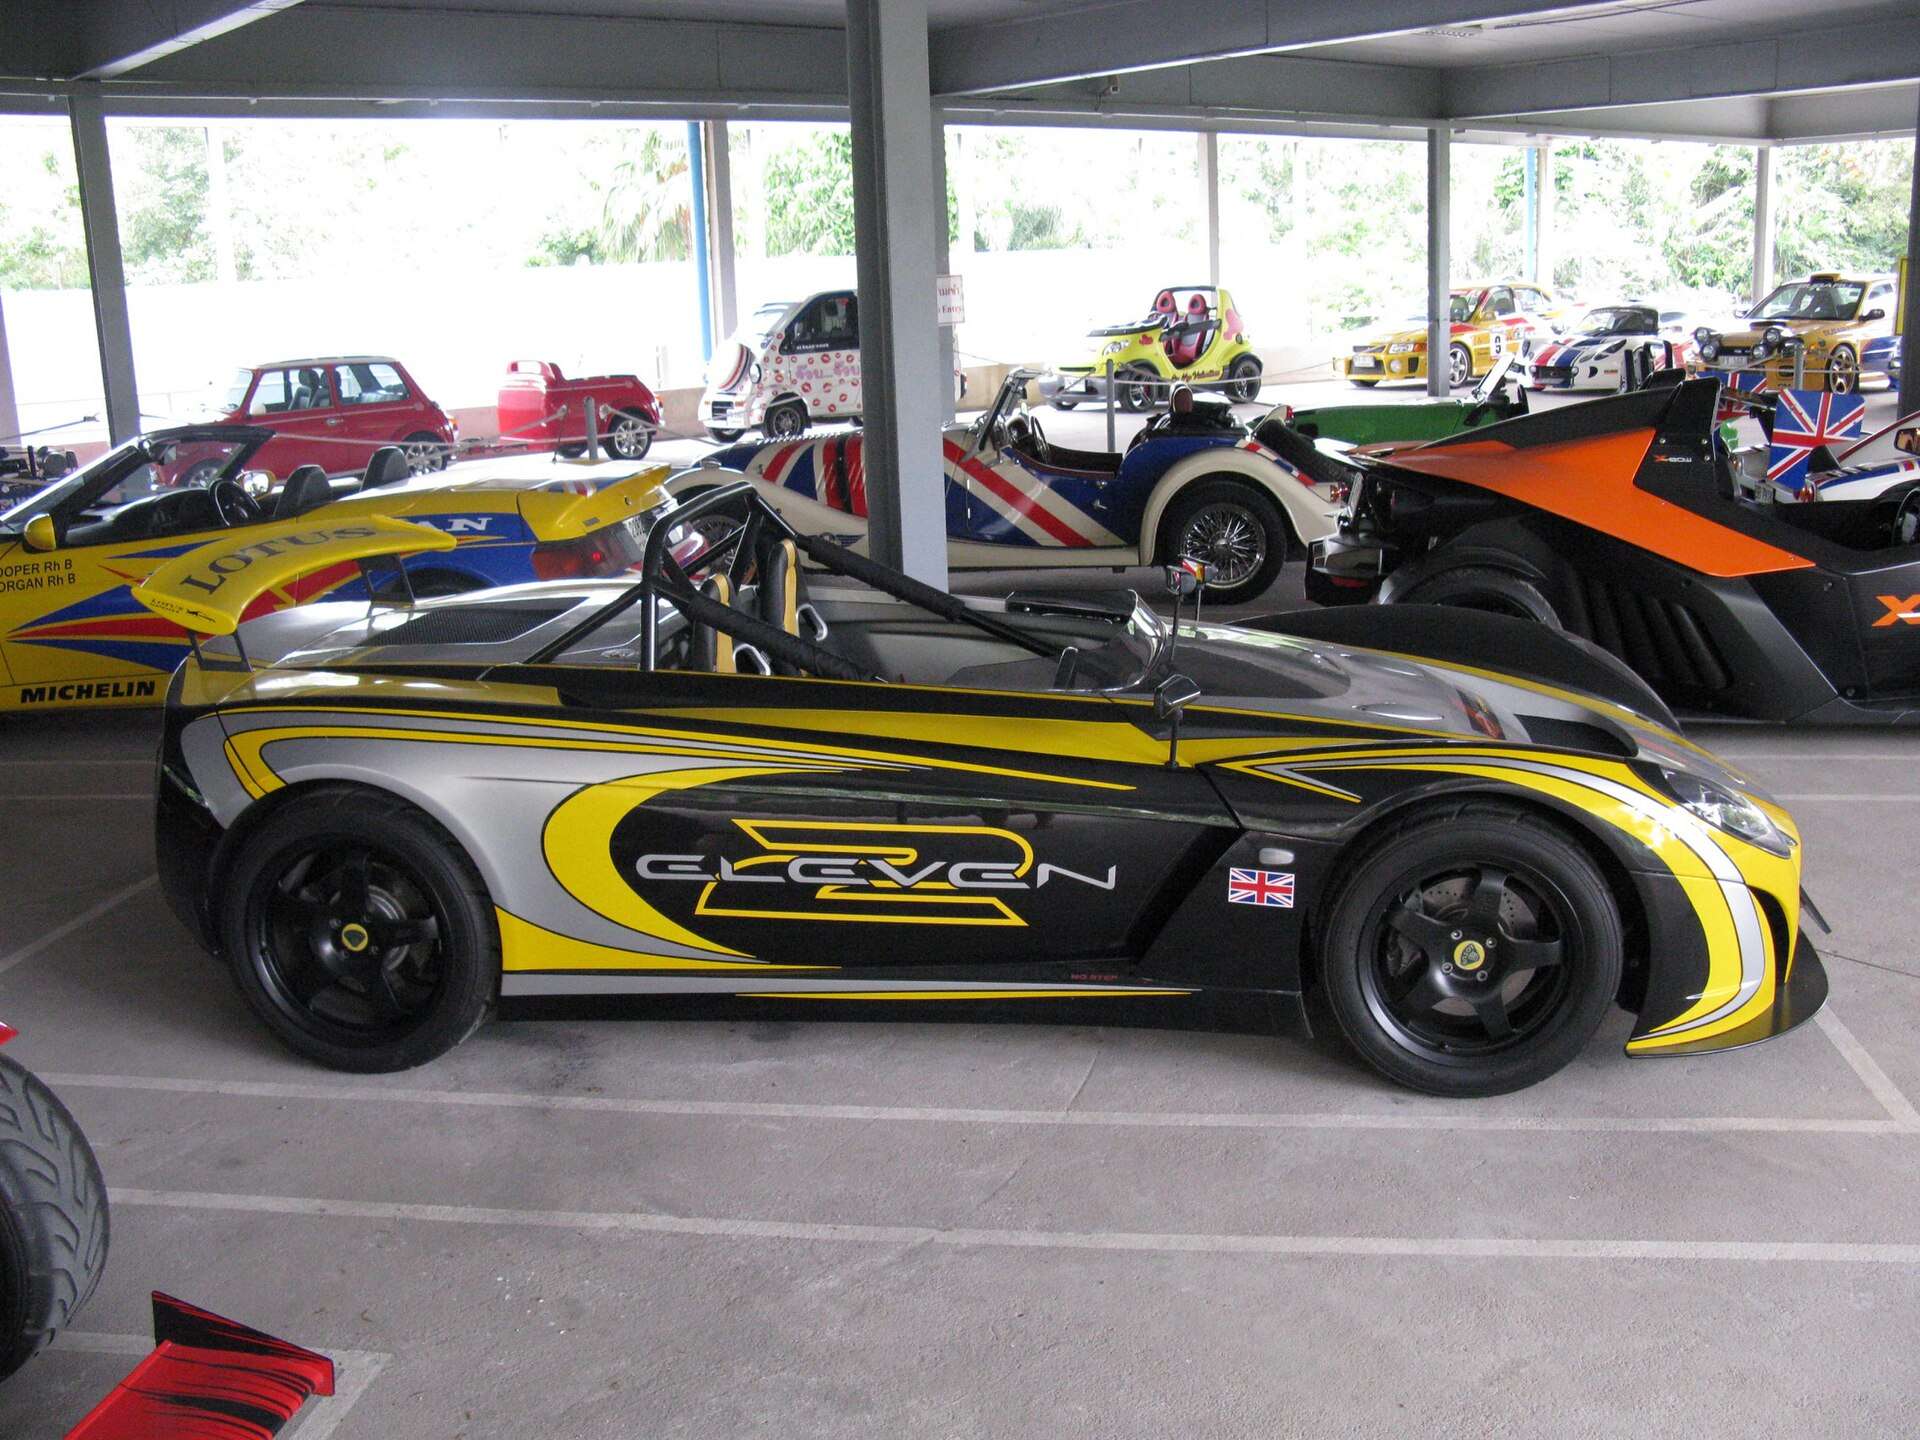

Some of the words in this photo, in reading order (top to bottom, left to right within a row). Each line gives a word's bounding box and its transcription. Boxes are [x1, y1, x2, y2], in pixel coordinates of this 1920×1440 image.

[44, 560, 60, 573] Rh
[64, 559, 73, 570] B
[180, 527, 377, 596] LOTUS
[48, 575, 64, 588] Rh
[67, 573, 76, 584] B
[20, 680, 156, 704] MICHELIN
[635, 853, 1117, 890] ELEVEN
